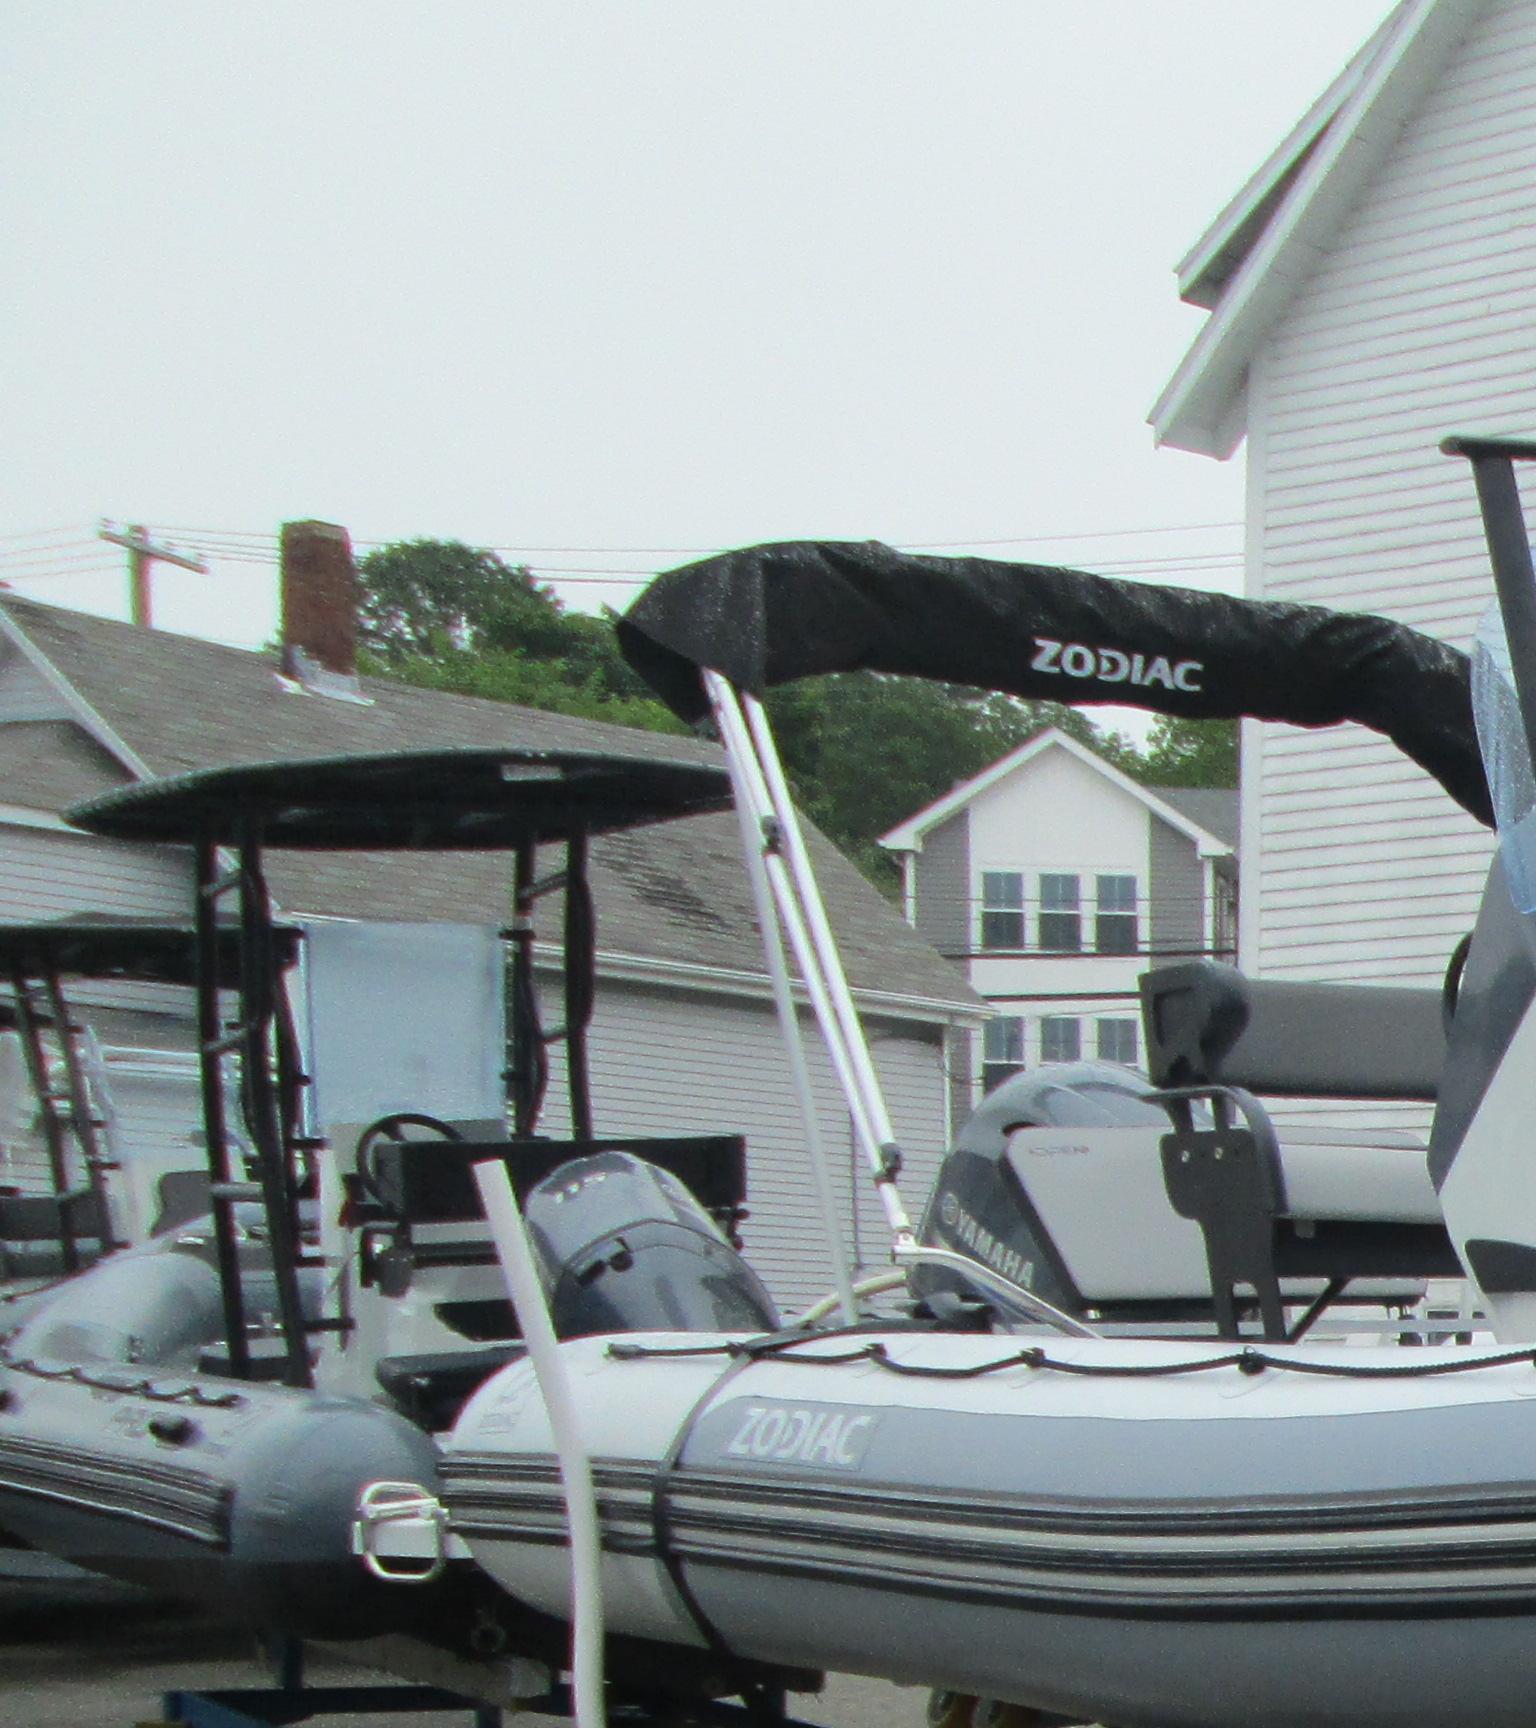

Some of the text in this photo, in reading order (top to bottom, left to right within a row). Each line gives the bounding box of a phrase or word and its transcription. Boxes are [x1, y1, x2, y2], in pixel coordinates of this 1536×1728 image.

[1031, 637, 1204, 692] ZODIAC
[957, 1208, 1034, 1289] YAMAHA
[727, 1407, 872, 1465] ZODIAC
